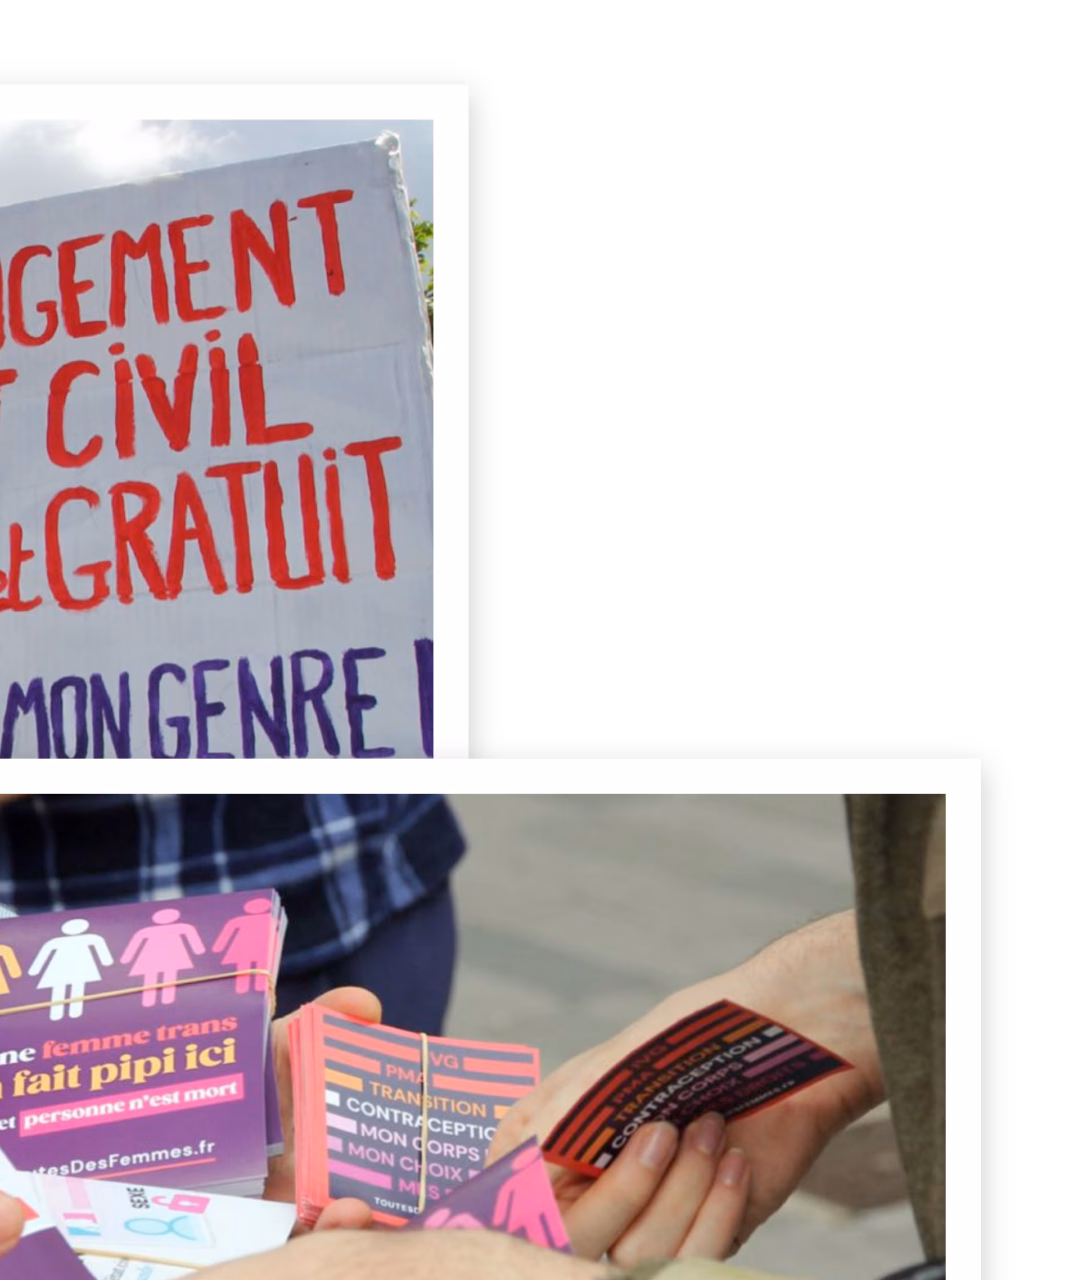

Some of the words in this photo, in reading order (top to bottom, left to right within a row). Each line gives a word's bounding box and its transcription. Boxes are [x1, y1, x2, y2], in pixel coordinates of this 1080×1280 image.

[3, 671, 130, 758] MON
[148, 647, 396, 758] GENRE
[42, 1029, 150, 1059] femme
[156, 1015, 238, 1042] trans
[12, 1064, 82, 1097] fait
[89, 1047, 175, 1091] pipi
[185, 1037, 237, 1071] ici
[427, 1051, 459, 1069] VG
[23, 1102, 126, 1130] personne
[129, 1090, 180, 1111] n'est
[183, 1081, 238, 1102] mort
[369, 1081, 487, 1117] TRANSITION
[611, 1035, 763, 1150] CONTRACEPTION
[33, 1139, 215, 1176] tesDesFemmes.fr
[348, 1142, 395, 1167] MON
[399, 1156, 463, 1182] CHOIX
[360, 1122, 407, 1148] MON
[412, 1137, 481, 1161] CORPS
